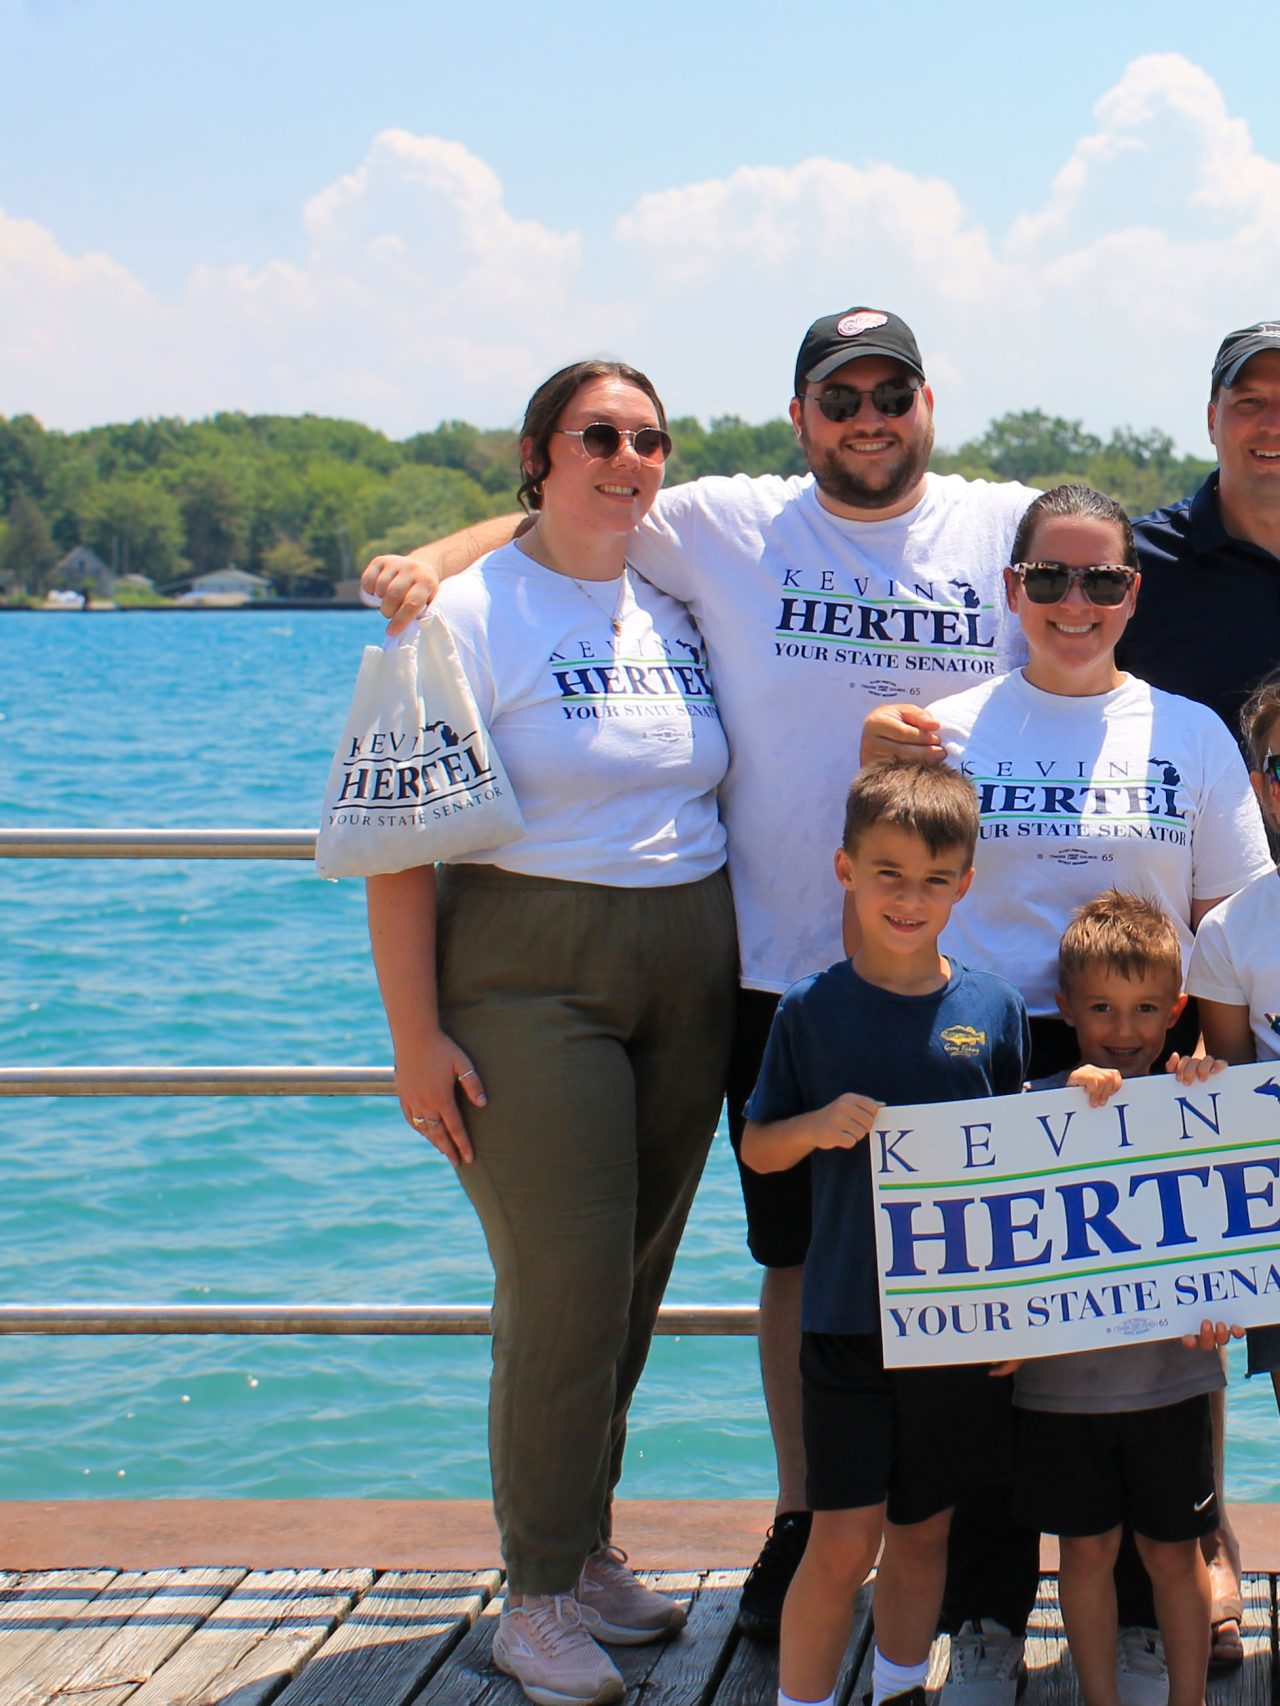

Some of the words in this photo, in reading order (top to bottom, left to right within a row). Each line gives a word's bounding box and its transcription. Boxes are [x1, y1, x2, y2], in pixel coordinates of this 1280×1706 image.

[783, 568, 934, 601] KEVIN
[775, 598, 995, 648] HERTEL
[774, 642, 828, 662] YOUR
[835, 648, 899, 669] STATE
[906, 656, 995, 675] SENATOR
[909, 687, 921, 696] 65
[562, 705, 619, 720] YOUR
[338, 746, 492, 801] HERTEL
[961, 761, 1129, 777] KEVIN
[329, 814, 371, 826] YOUR
[378, 813, 427, 827] STATE
[434, 787, 503, 819] SENATOR
[980, 824, 1009, 840] UR
[1018, 822, 1090, 839] STATE
[1098, 823, 1186, 846] SENATOR
[1102, 854, 1114, 862] 65
[875, 1093, 1223, 1174] KEVIN
[886, 1301, 1012, 1338] YOUR
[1028, 1280, 1161, 1328] STATE
[1159, 1318, 1169, 1327] 65
